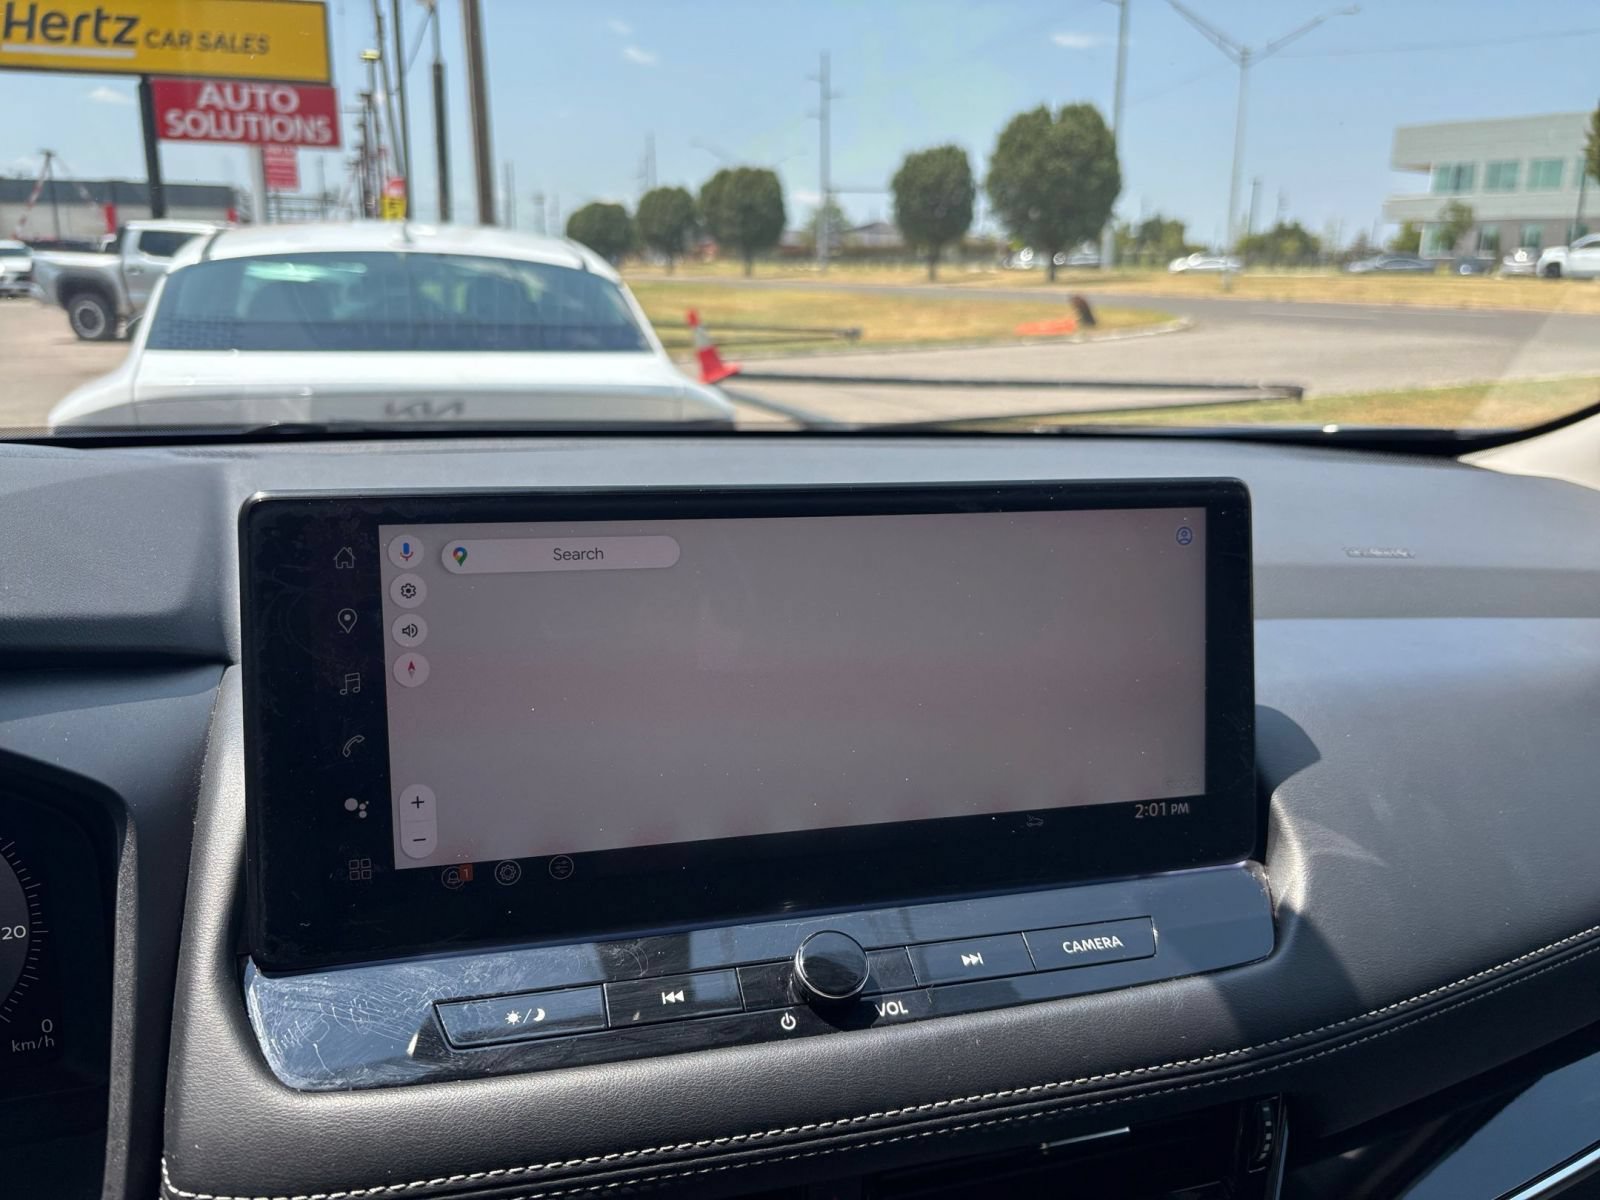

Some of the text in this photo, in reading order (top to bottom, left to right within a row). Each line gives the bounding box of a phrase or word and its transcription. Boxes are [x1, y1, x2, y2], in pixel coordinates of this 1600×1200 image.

[3, 2, 270, 54] Hertz CAR SALES
[197, 84, 299, 115] AUTO
[164, 109, 332, 145] SOLUTIONS
[552, 546, 605, 562] Search
[1134, 802, 1190, 819] 2:01 PM
[1062, 934, 1124, 954] CAMERA
[876, 999, 909, 1017] VOL
[41, 1018, 54, 1033] 0
[11, 1035, 55, 1053] km/h
